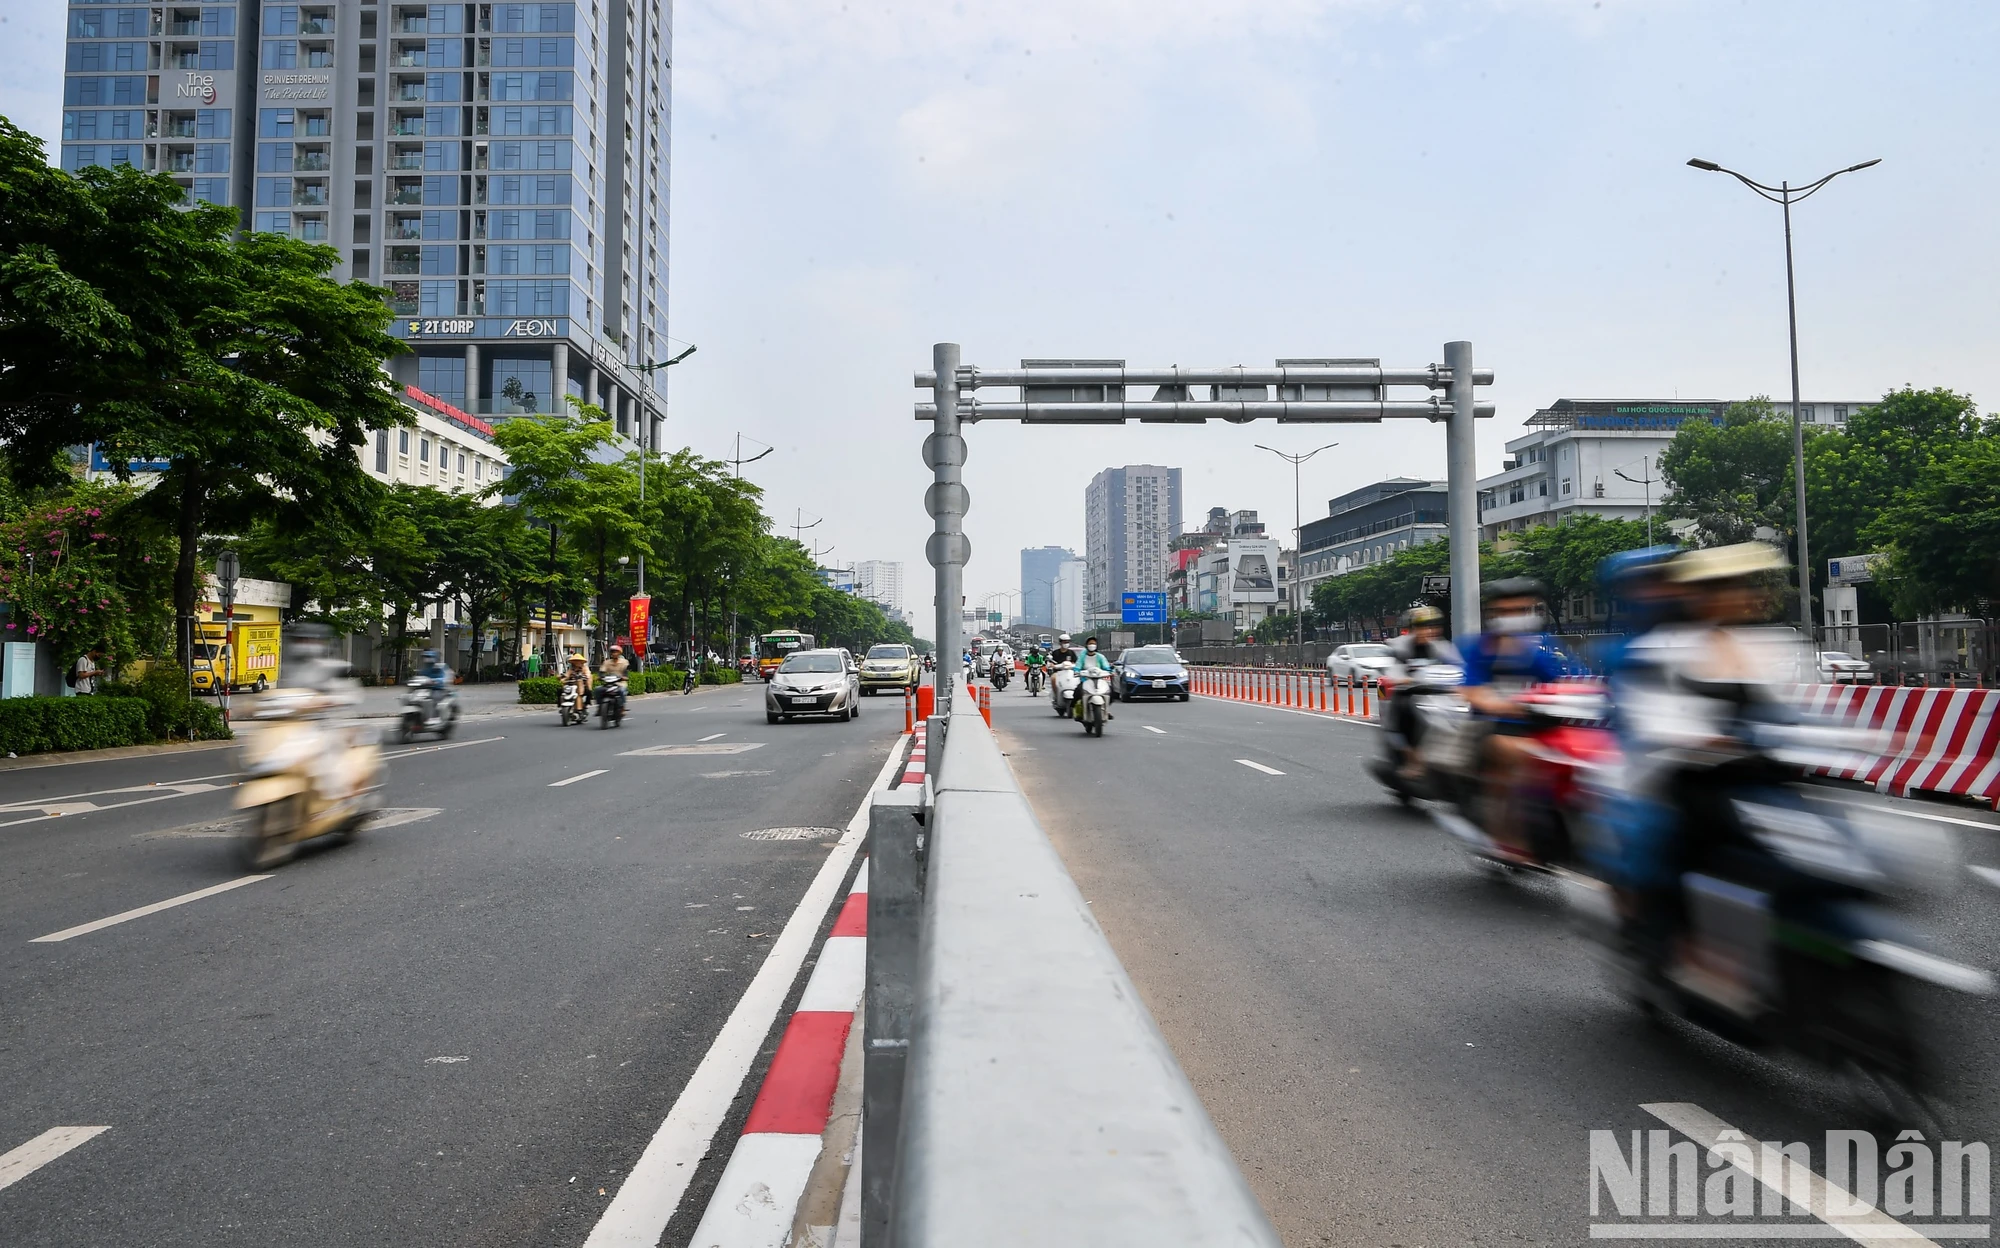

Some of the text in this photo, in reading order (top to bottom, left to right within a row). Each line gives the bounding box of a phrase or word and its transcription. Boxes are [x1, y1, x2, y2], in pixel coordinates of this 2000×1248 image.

[186, 72, 214, 85] The
[263, 75, 330, 84] GP.INVEST PREMIUM
[177, 83, 215, 100] Nine
[264, 87, 328, 101] The Perfect Life
[424, 320, 474, 334] 2T CORP
